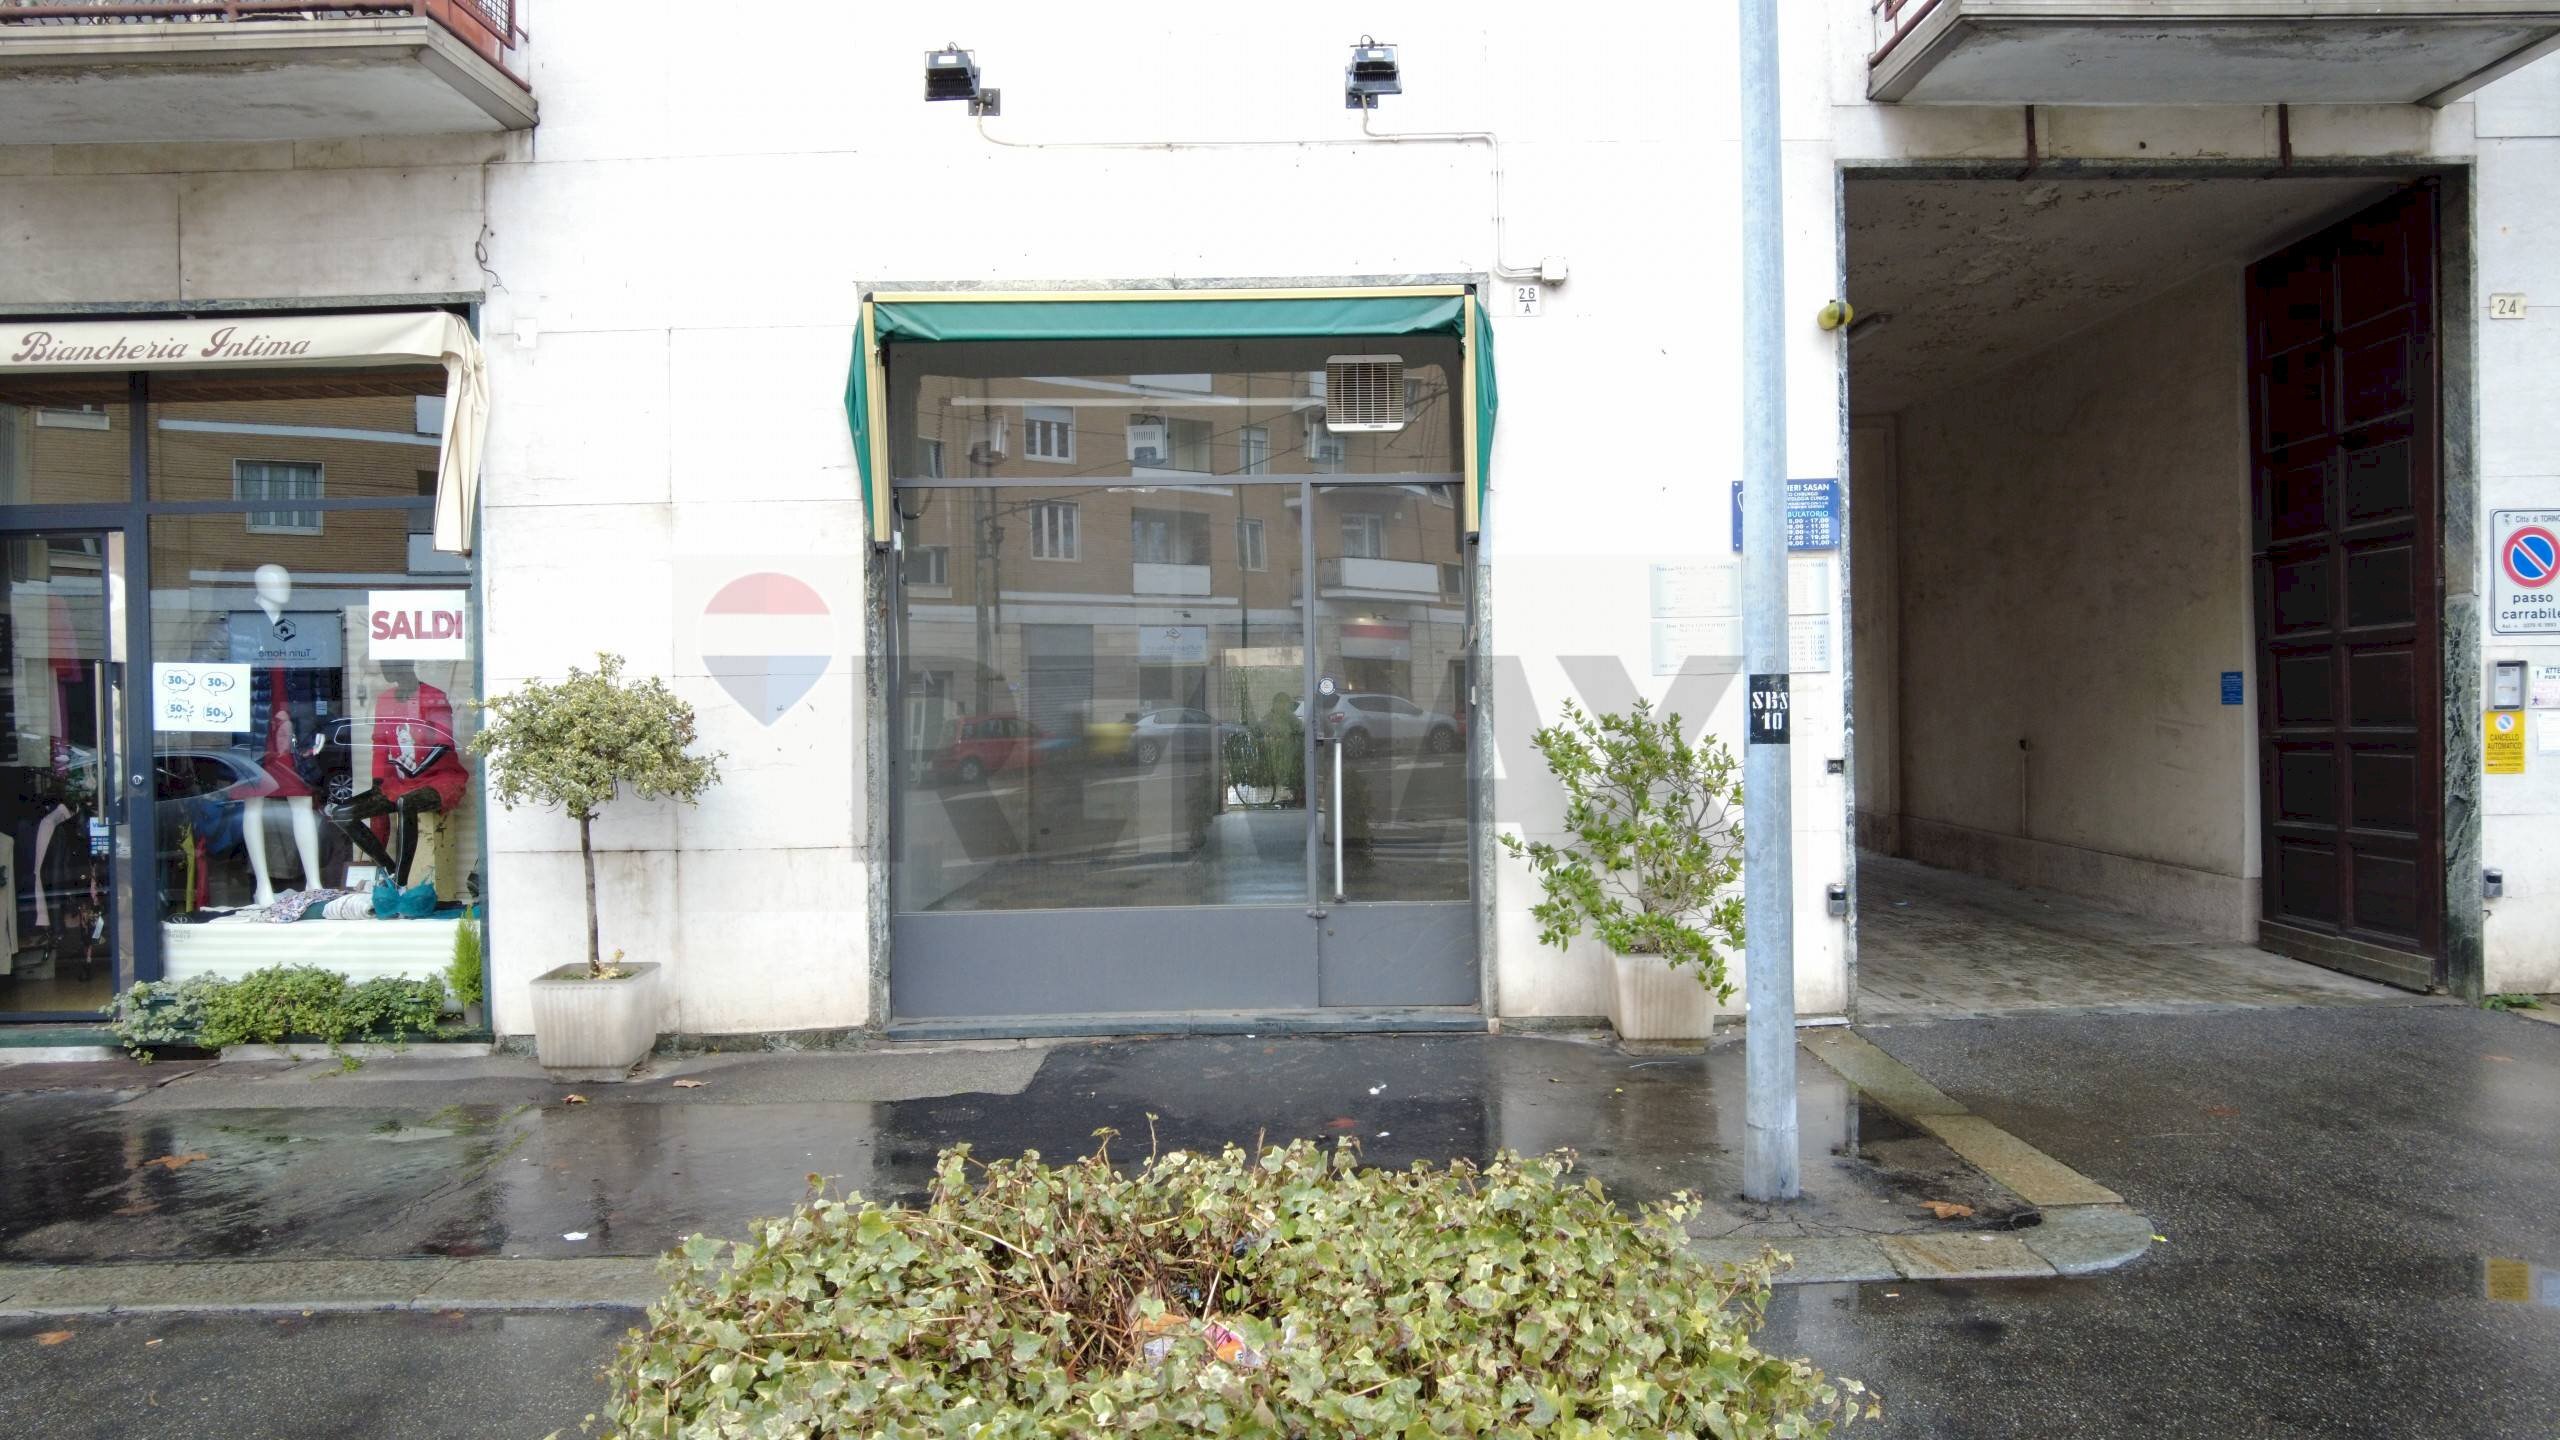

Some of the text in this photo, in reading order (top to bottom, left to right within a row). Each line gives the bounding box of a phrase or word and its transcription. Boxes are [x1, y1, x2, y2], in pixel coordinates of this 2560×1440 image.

[1518, 287, 1536, 300] 26
[1524, 302, 1532, 314] A
[2498, 298, 2517, 315] 24
[11, 326, 312, 363] Biancheria Intima
[1803, 483, 1830, 491] SASAN
[2512, 594, 2553, 605] passo
[371, 610, 463, 641] SALDI
[1752, 691, 1789, 710] SBS
[1761, 712, 1783, 730] 10
